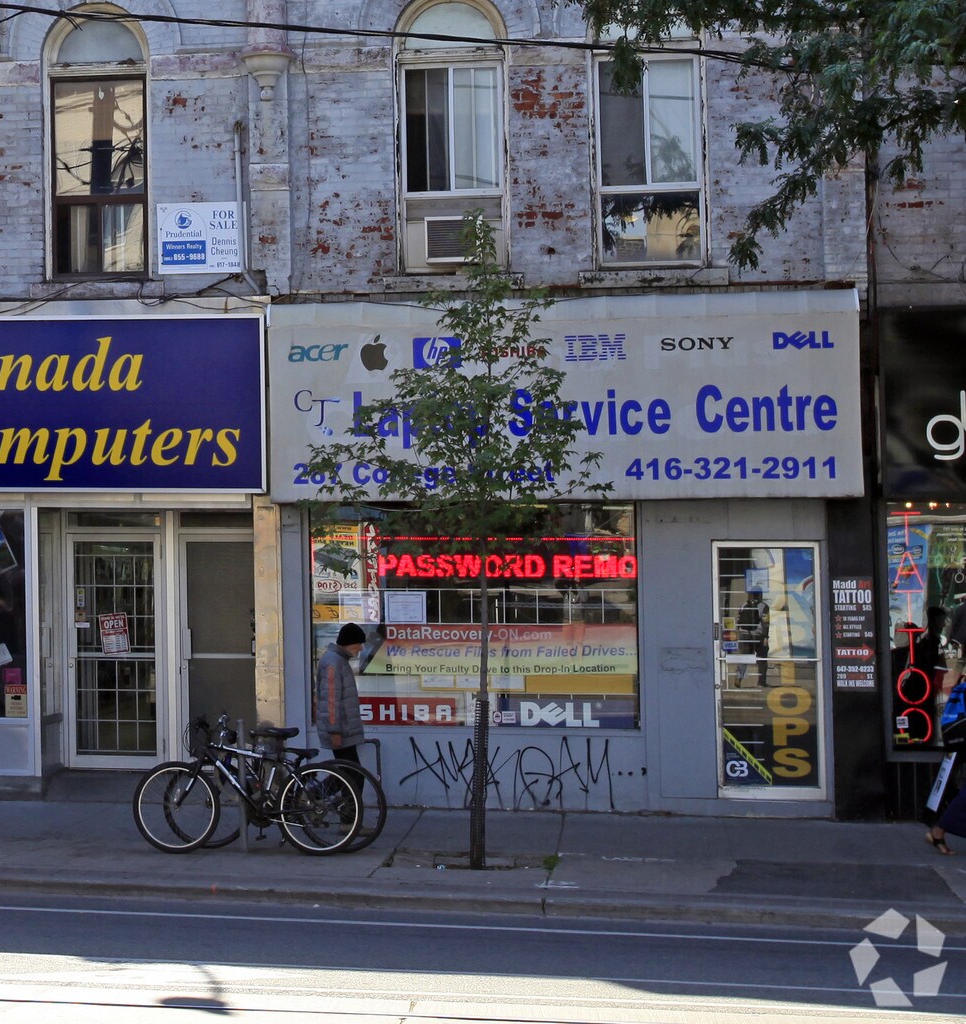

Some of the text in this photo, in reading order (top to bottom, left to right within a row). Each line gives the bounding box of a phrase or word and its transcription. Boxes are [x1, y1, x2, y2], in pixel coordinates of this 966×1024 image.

[212, 210, 235, 219] FOR
[209, 221, 238, 230] SALE
[165, 230, 202, 238] Prudential
[212, 237, 237, 246] Dennis
[210, 246, 238, 256] Cheung
[288, 343, 349, 362] acer
[564, 334, 627, 362] IBM
[660, 336, 734, 352] SONY
[772, 331, 834, 350] DELL
[695, 383, 838, 434] Centre
[625, 456, 837, 481] 416-321-2911
[378, 554, 547, 578] PASSWORD
[833, 579, 857, 589] Madd
[833, 589, 872, 604] TATTOO
[834, 604, 857, 612] STARTING
[103, 620, 125, 629] OPEN
[386, 645, 407, 658] We
[410, 645, 462, 658] Rescue
[502, 645, 533, 658] from
[536, 644, 578, 658] Failed
[385, 663, 412, 675] Bring
[414, 664, 438, 674] Your
[439, 663, 470, 676] Faulty
[500, 665, 510, 674] to
[512, 664, 531, 674] this
[533, 664, 571, 675] Drop-In
[572, 663, 616, 674] Location
[359, 703, 453, 722] SHIBA
[520, 701, 601, 727] DELL
